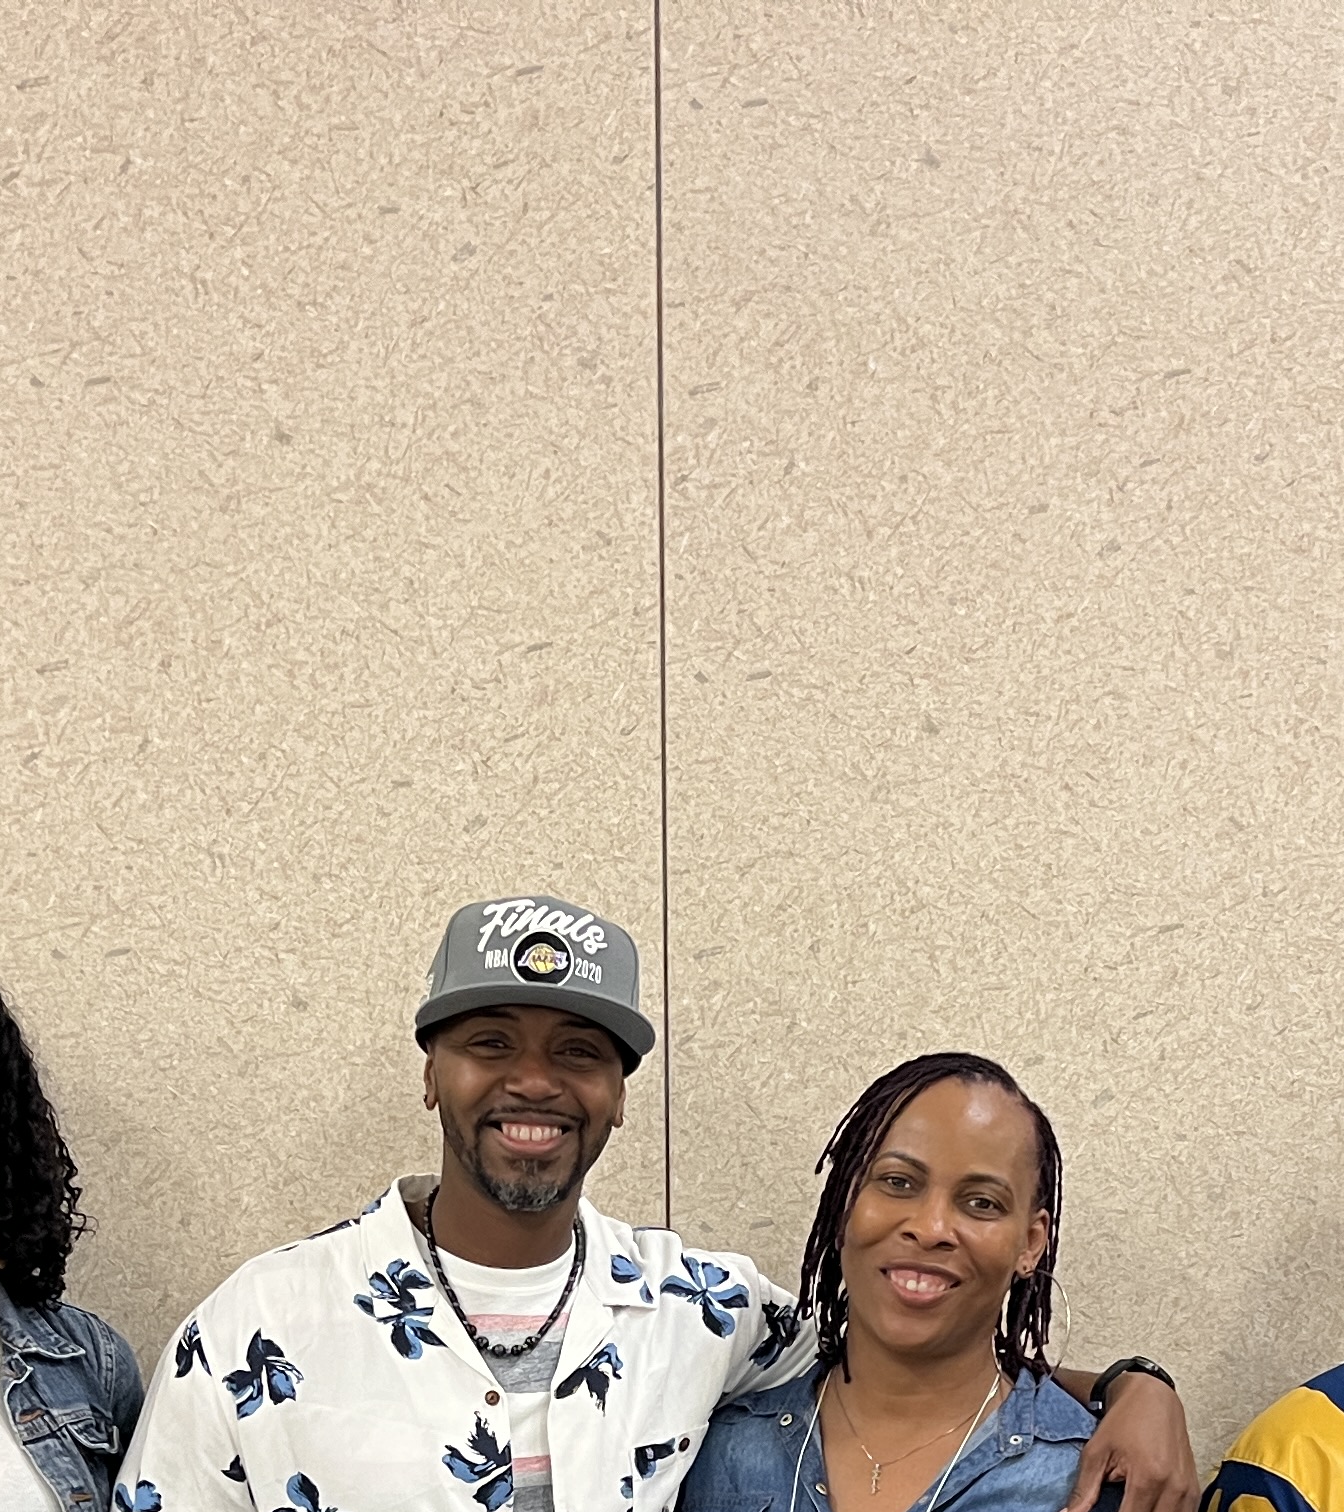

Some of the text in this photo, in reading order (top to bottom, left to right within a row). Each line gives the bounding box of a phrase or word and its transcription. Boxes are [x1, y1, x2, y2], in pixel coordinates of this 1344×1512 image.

[477, 898, 608, 955] Finals
[484, 949, 603, 985] NBA 2020
